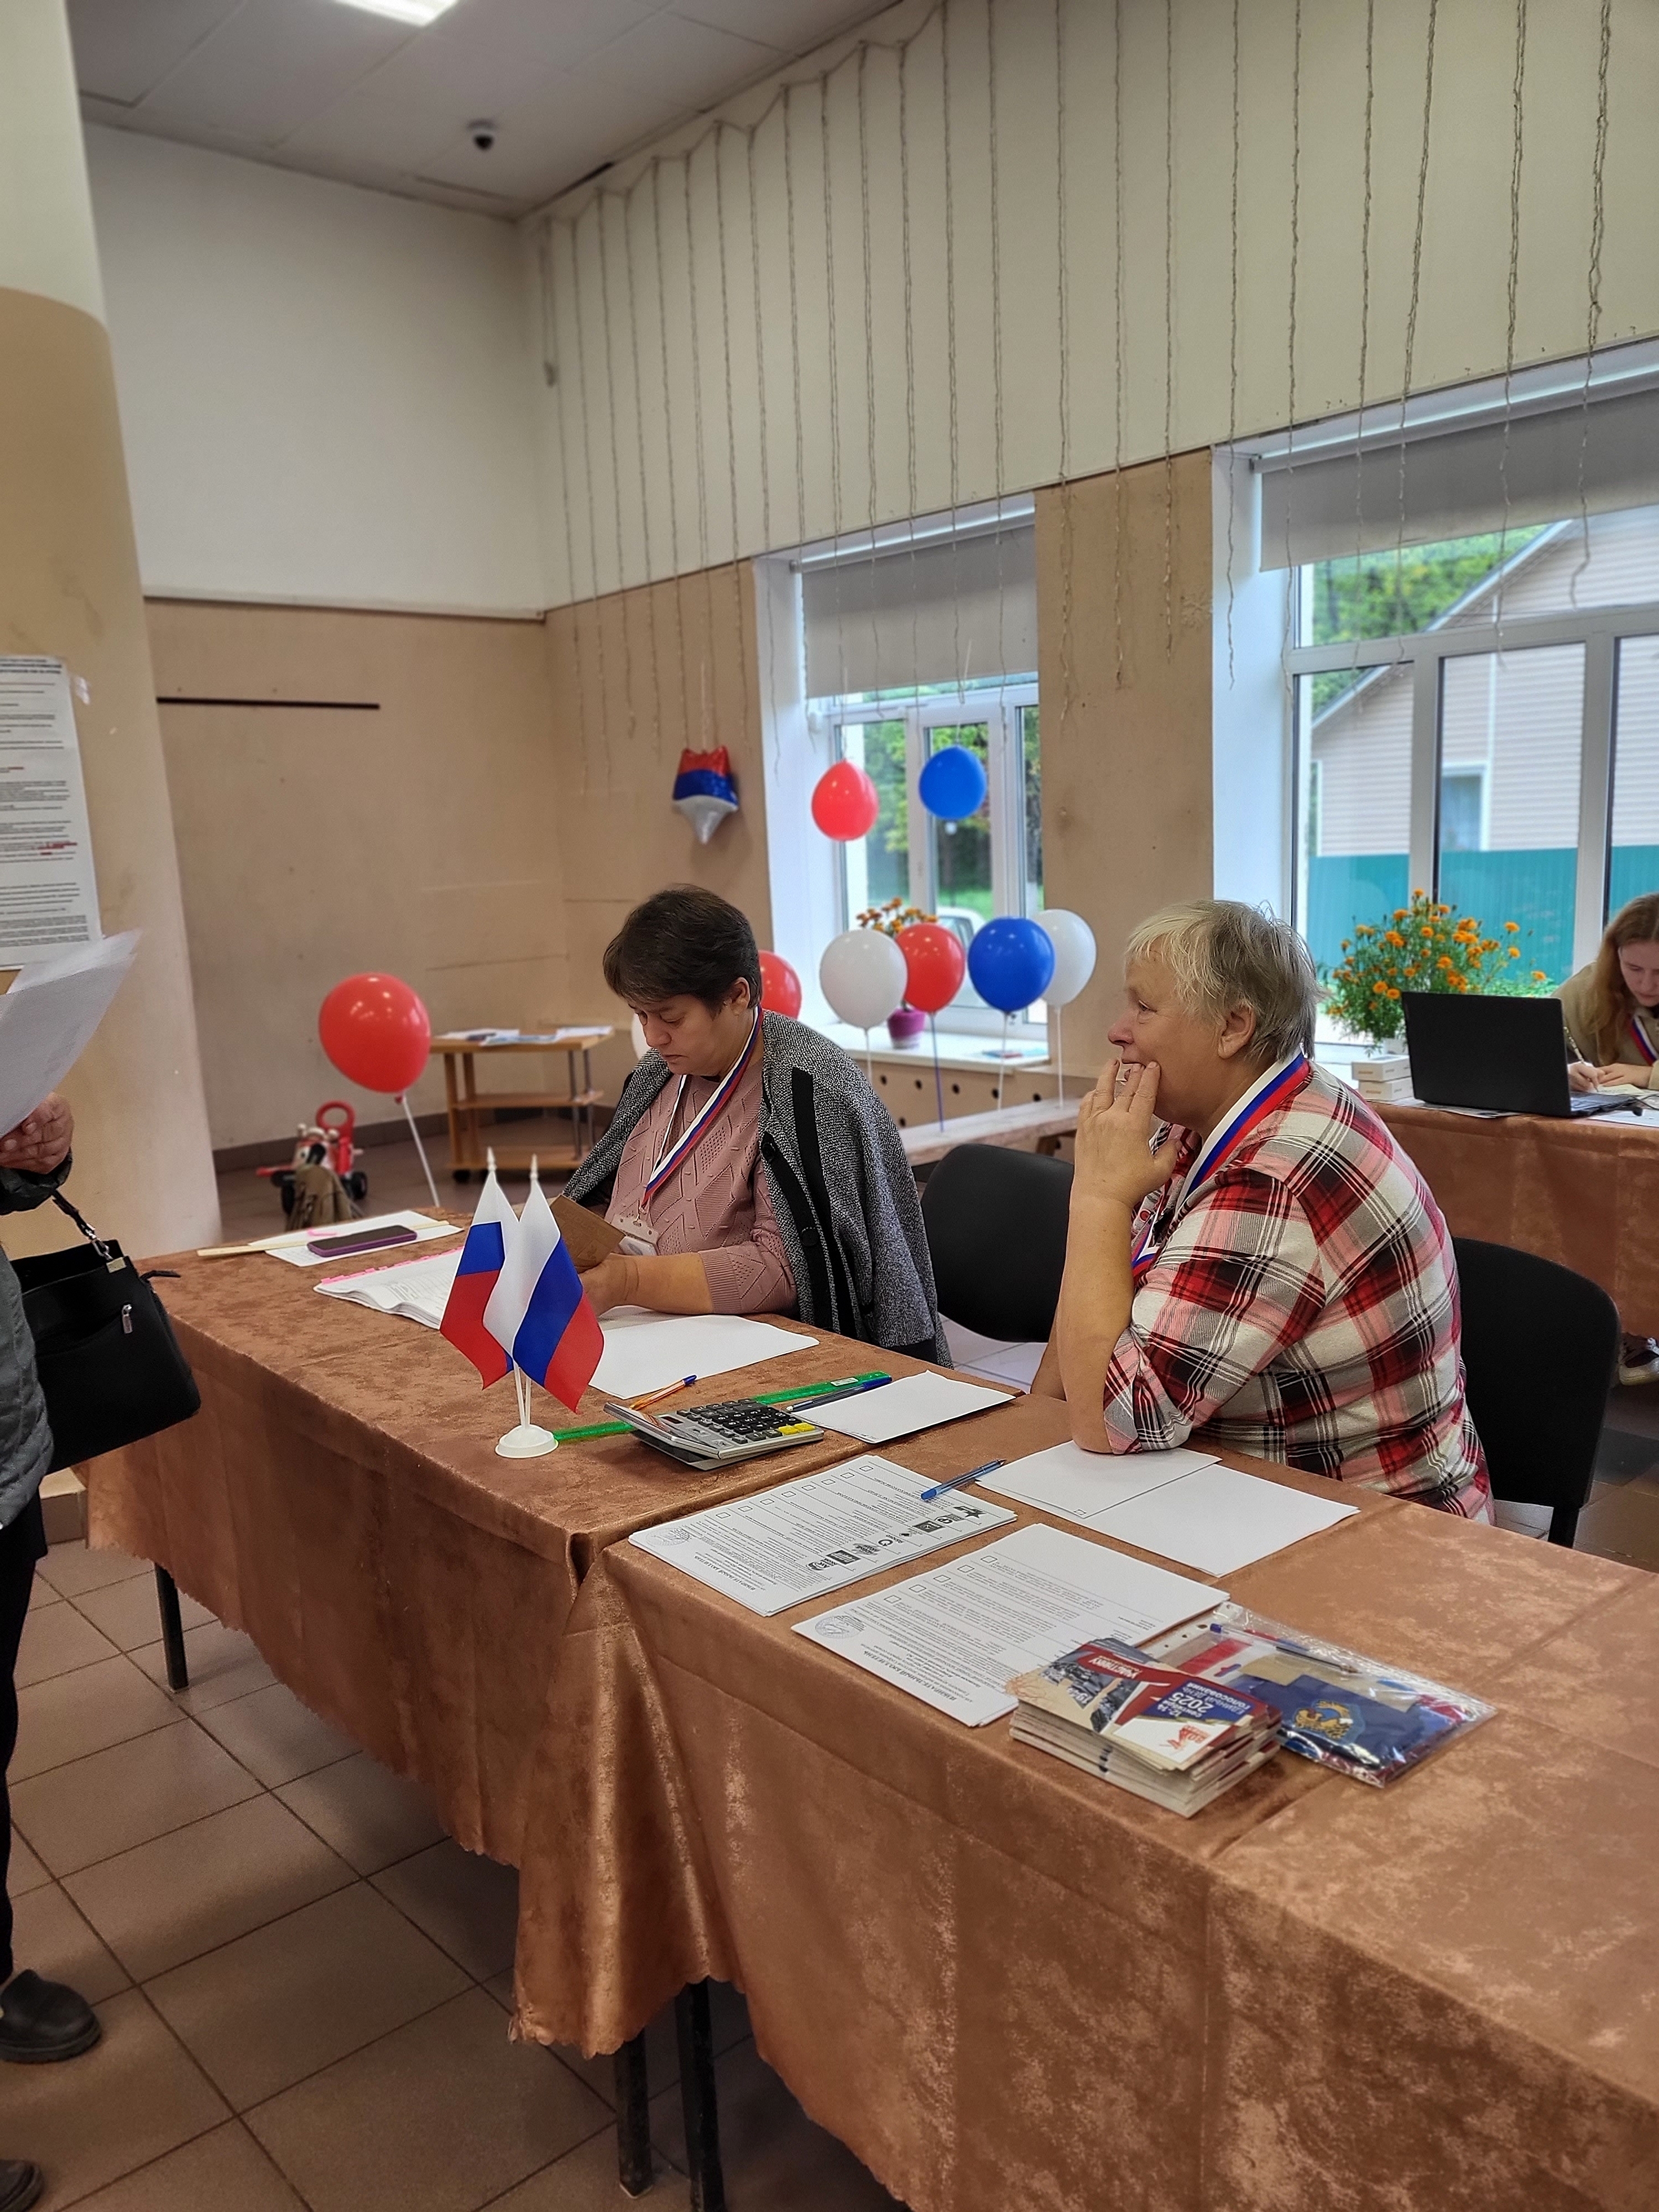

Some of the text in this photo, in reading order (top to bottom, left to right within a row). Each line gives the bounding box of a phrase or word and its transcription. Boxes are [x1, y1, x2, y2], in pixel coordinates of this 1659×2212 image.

[830, 1552, 854, 1562] ЛДПР
[1162, 1700, 1202, 1717] сентября
[1168, 1692, 1214, 1713] 2025
[1182, 1687, 1245, 1714] ЕДИНЫЙ ДЕНЬ
[1157, 1704, 1181, 1717] 12-14
